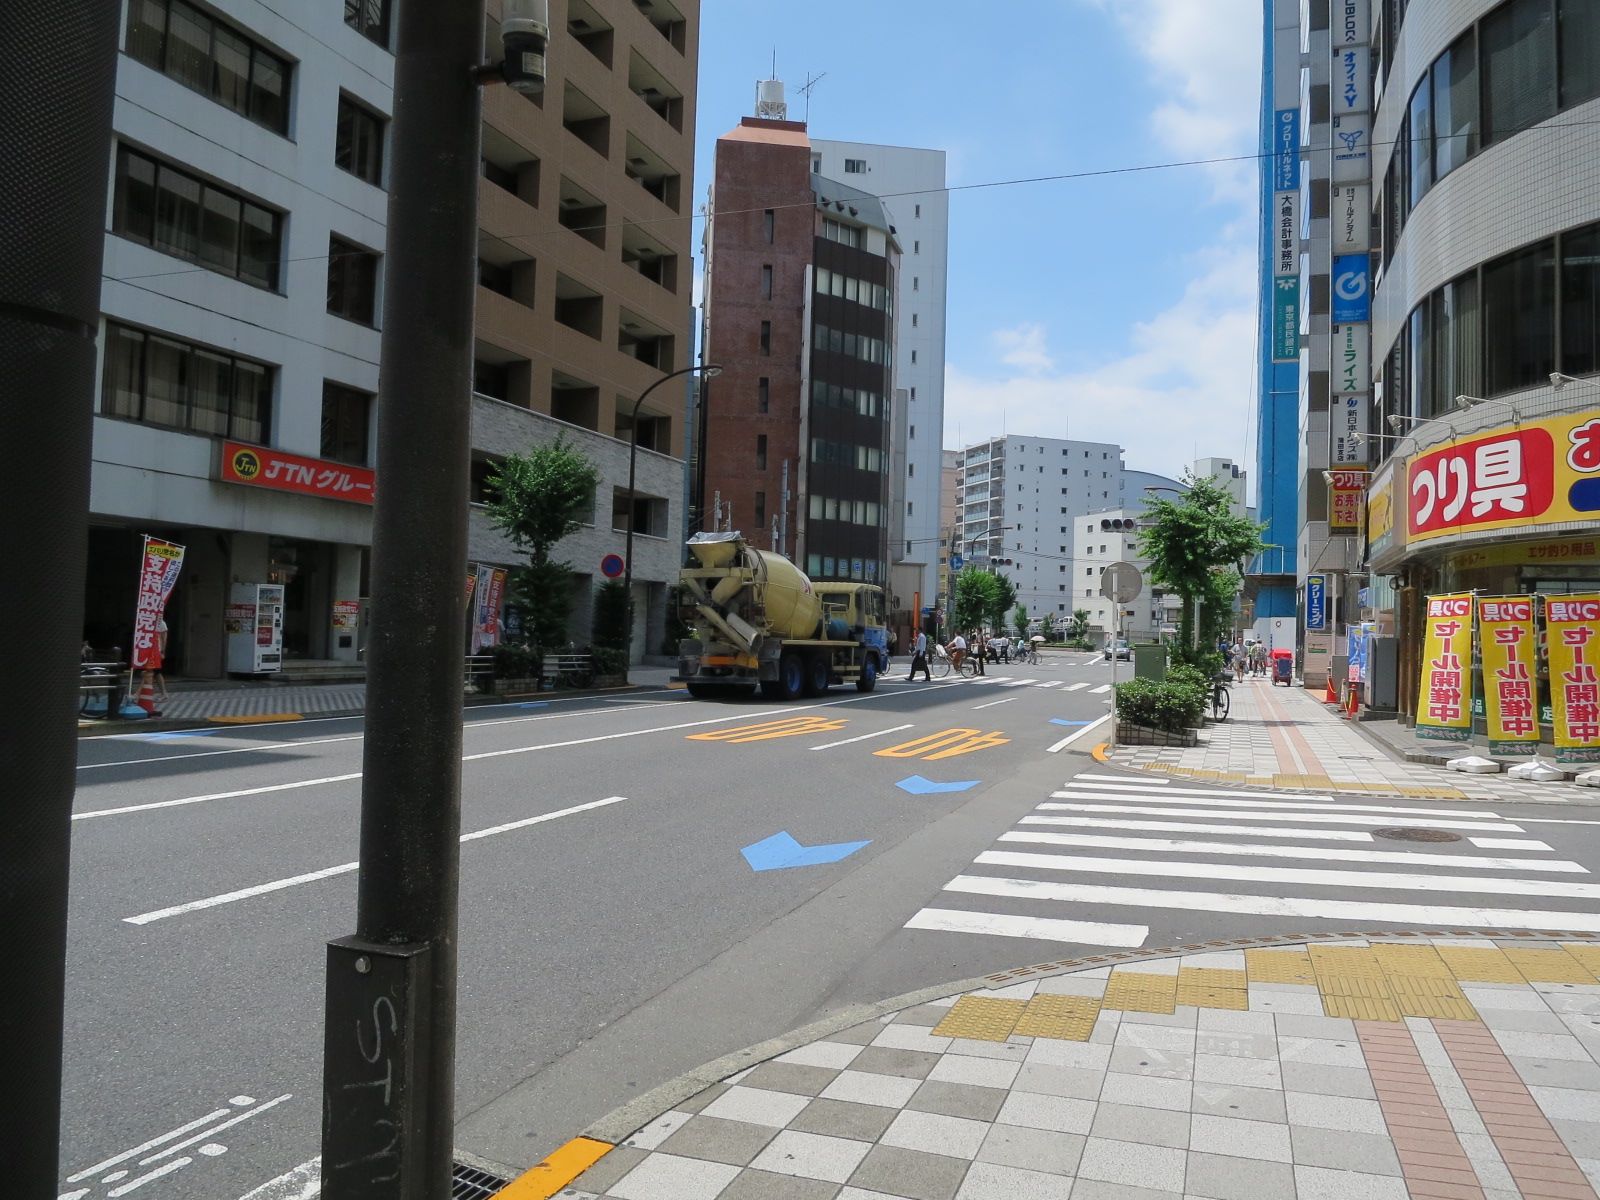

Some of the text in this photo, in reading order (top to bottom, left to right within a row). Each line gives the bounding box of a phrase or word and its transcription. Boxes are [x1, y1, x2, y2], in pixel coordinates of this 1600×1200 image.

[1281, 194, 1292, 272] 大橋会計事務所
[1334, 473, 1364, 487] つり具
[1412, 439, 1527, 526] つり具
[133, 554, 166, 667] 支持政党なし
[1311, 585, 1323, 625] クリーニング
